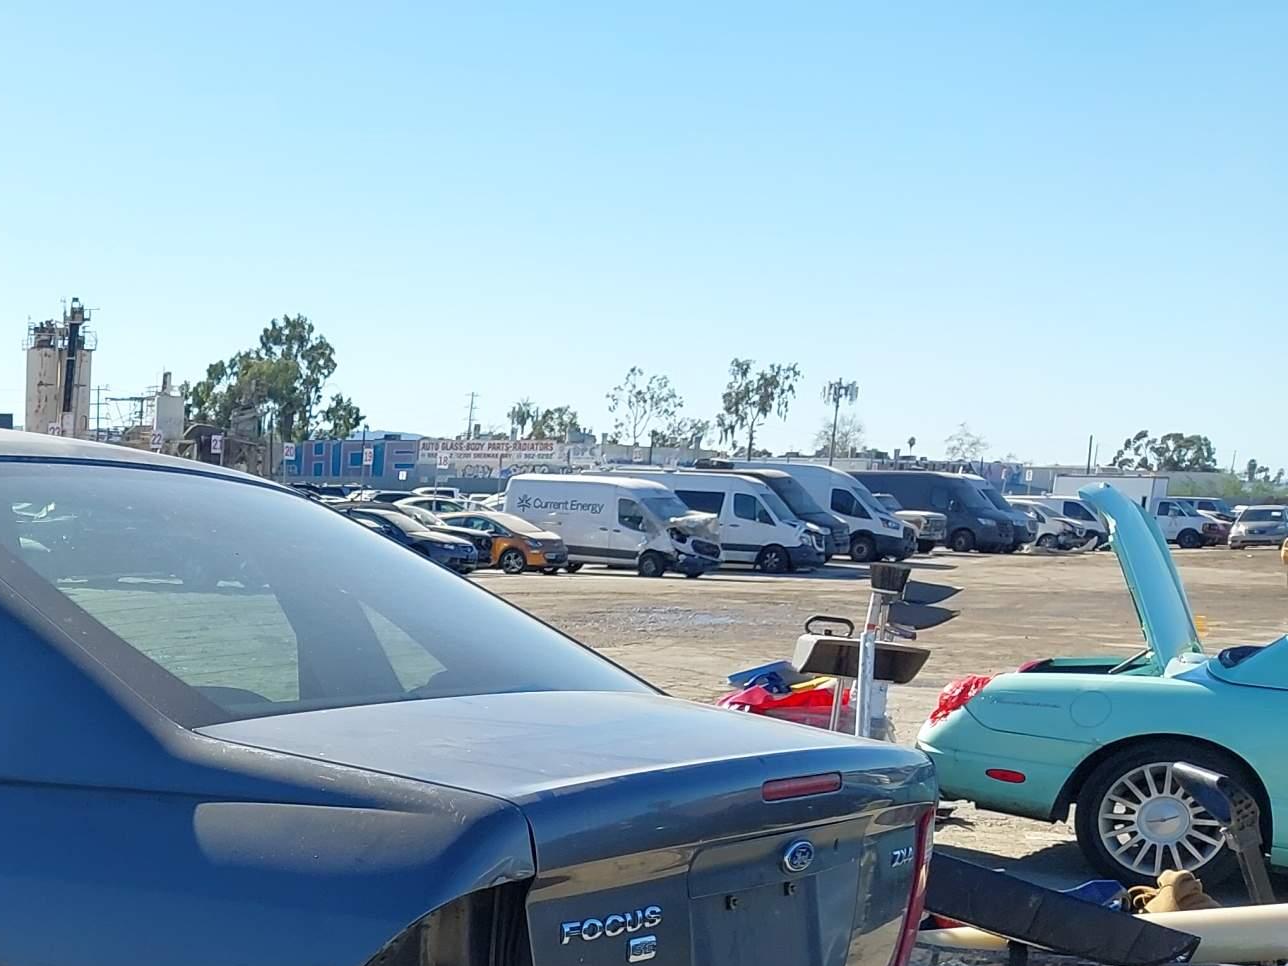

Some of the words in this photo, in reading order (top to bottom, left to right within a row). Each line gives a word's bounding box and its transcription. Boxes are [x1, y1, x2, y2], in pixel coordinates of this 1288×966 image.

[151, 433, 162, 445] 22
[285, 445, 294, 456] 20
[421, 441, 439, 451] AUTO
[364, 449, 372, 462] 19
[438, 455, 448, 466] 18
[533, 498, 568, 510] Current
[570, 500, 605, 514] Energy
[561, 905, 663, 945] FOCUS
